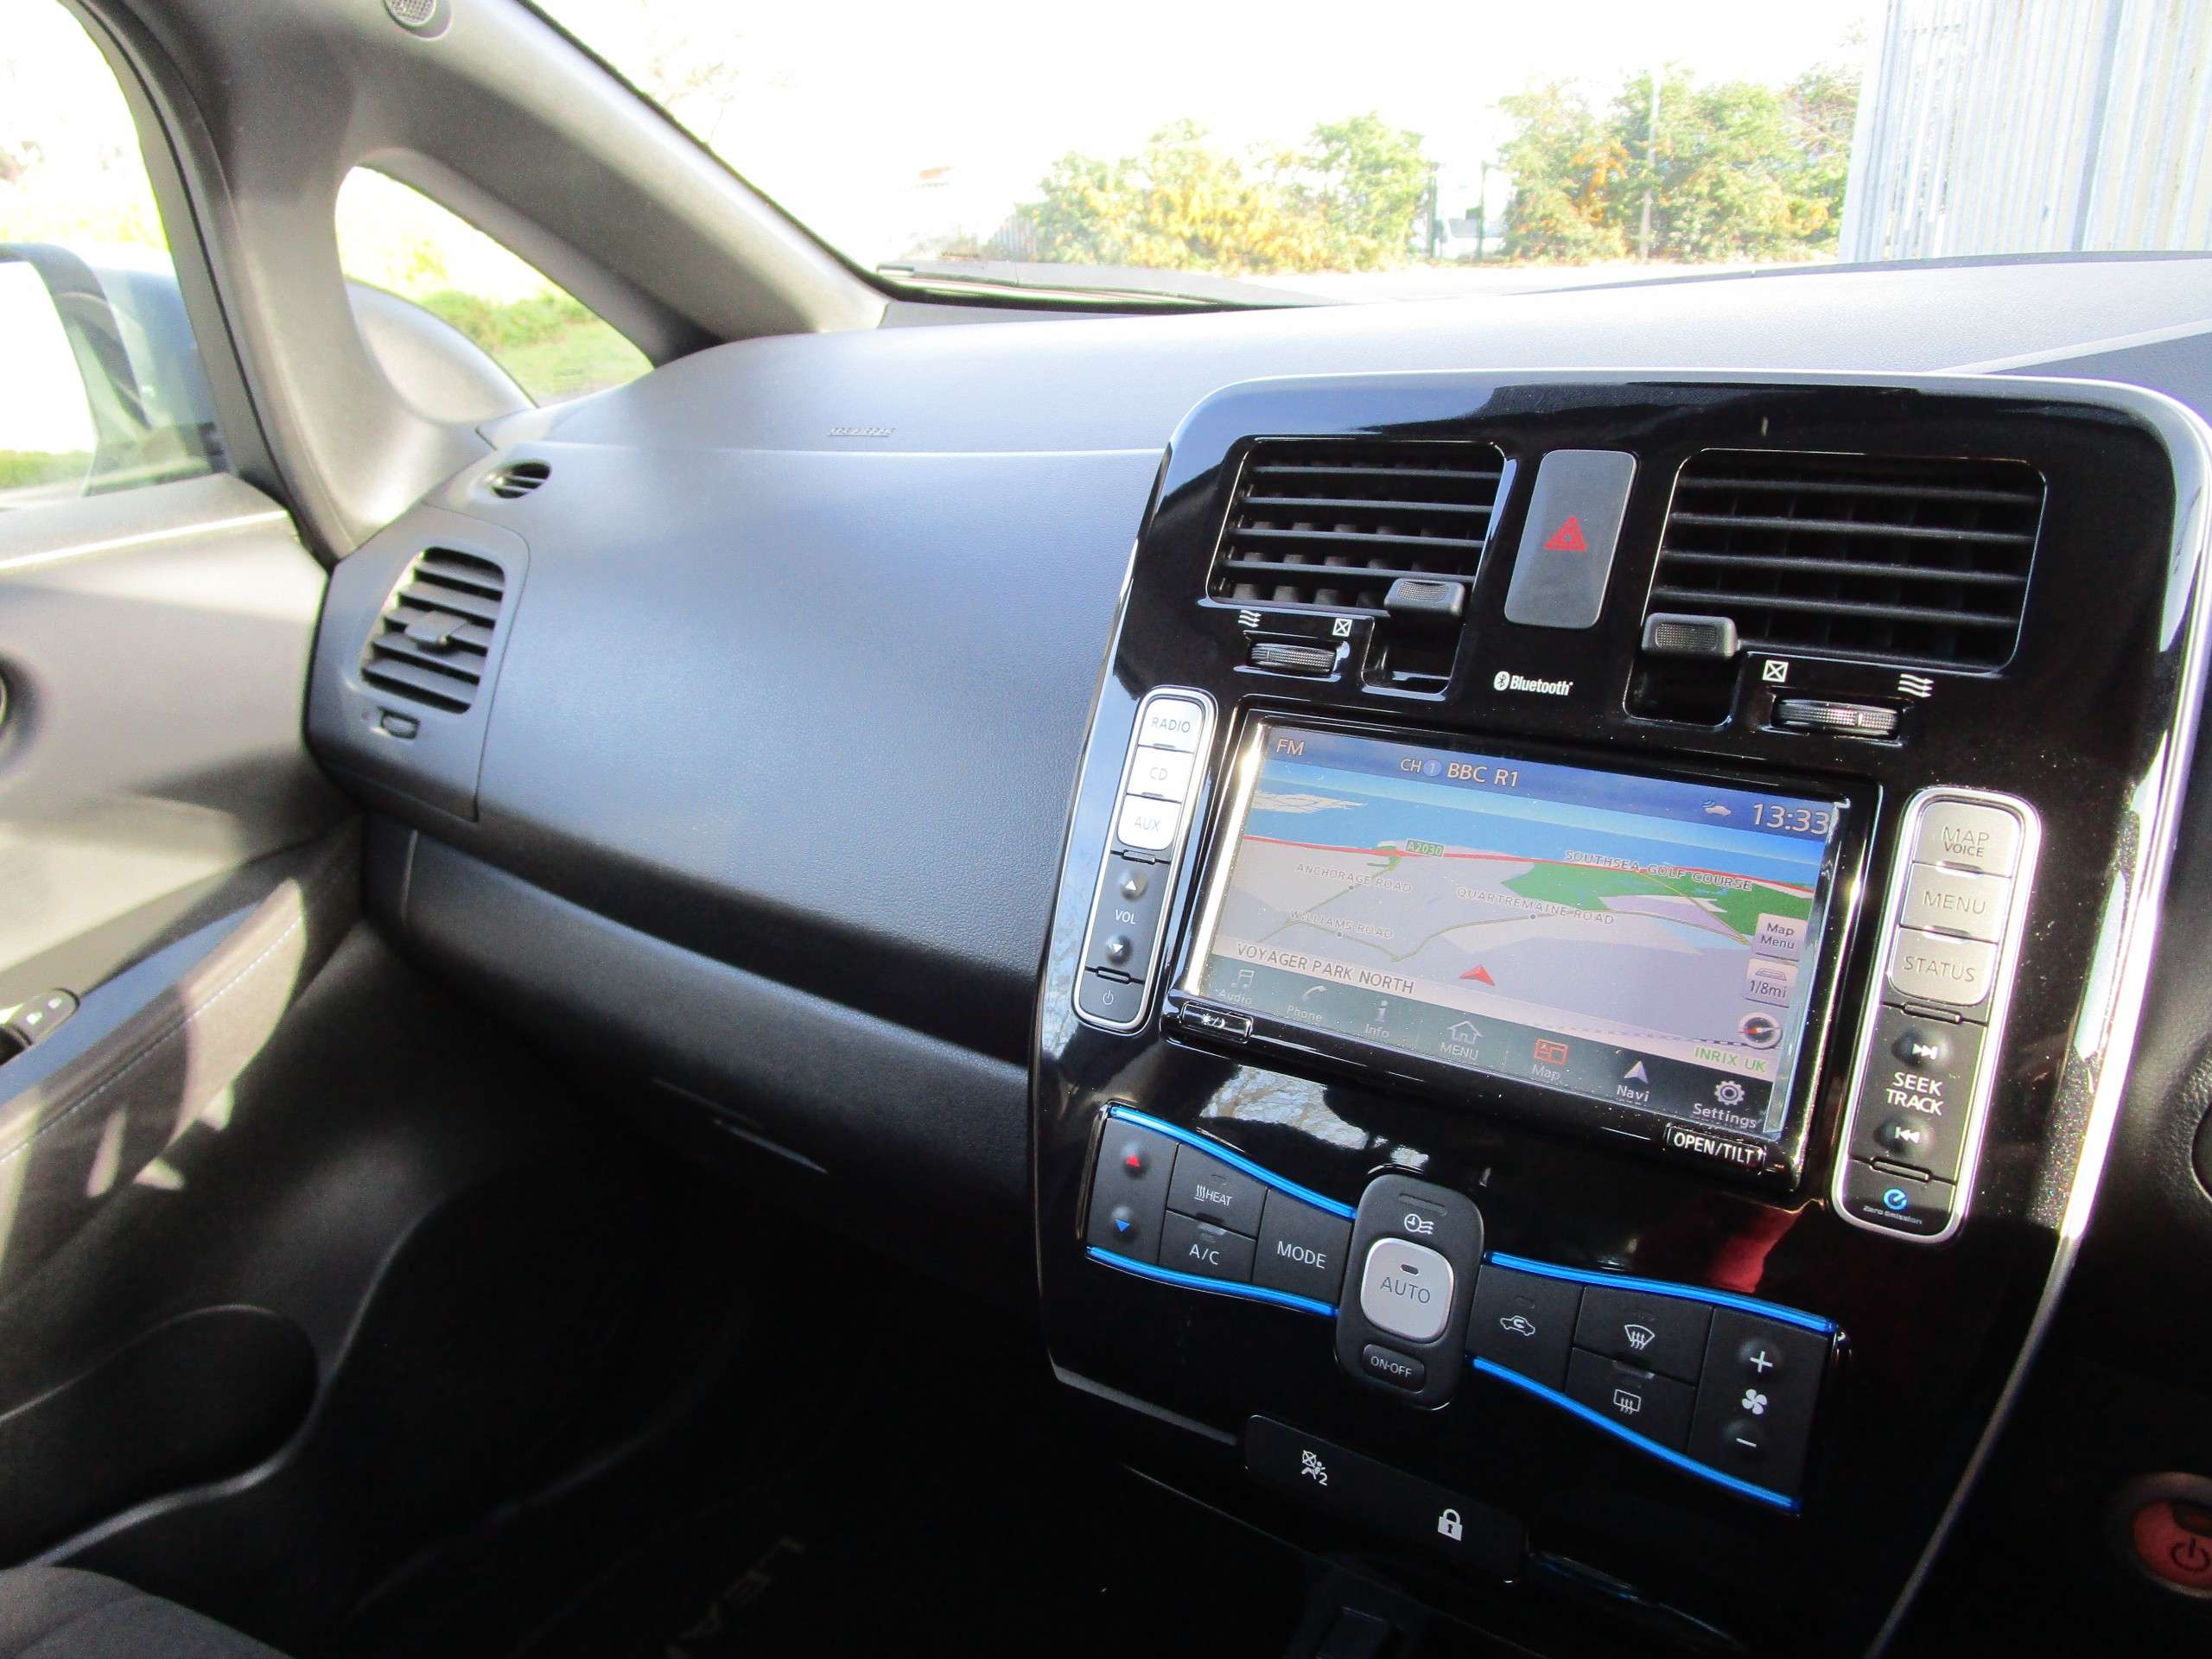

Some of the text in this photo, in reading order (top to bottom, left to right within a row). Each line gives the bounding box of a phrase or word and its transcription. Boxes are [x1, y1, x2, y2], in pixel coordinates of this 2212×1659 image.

[1510, 675, 1570, 696] Bluetooth
[1150, 716, 1192, 734] RADIO
[1276, 738, 1306, 756] FM
[1149, 767, 1168, 782] CD
[1400, 758, 1422, 773] CH
[1447, 761, 1487, 783] BBC
[1494, 769, 1520, 788] R1
[1134, 817, 1161, 832] AUX
[1753, 803, 1829, 835] 13:33
[1942, 826, 1990, 846] MAP
[1407, 842, 1442, 855] A2030
[1943, 842, 1985, 858] VOICE
[1296, 863, 1413, 893] ANCHORAGE ROAD
[1564, 849, 1753, 892] SOUTHSEA GOLF COURSE
[1458, 888, 1615, 925] QUARTREMAINE ROAD
[1923, 891, 1986, 915] MENU
[1116, 909, 1136, 925] VOL
[1356, 924, 1394, 939] ROAD
[1766, 922, 1795, 937] Map
[1760, 935, 1795, 950] Menu
[1236, 943, 1414, 995] VOYAGER PARK NORTH
[1904, 956, 1975, 982] STATUS
[1217, 989, 1252, 1005] Audio
[1750, 980, 1787, 998] 1/8mi
[1287, 1004, 1323, 1023] Phone
[1364, 1022, 1390, 1039] Info
[1440, 1040, 1480, 1061] MENU
[1694, 1046, 1768, 1073] INRIX UK
[1532, 1064, 1561, 1083] Map
[1892, 1071, 1943, 1096] SEEK
[1617, 1084, 1650, 1103] Navi
[1885, 1088, 1944, 1116] TRACK
[1693, 1103, 1757, 1130] Settings
[1674, 1130, 1755, 1164] OPEN/TILT
[1205, 1191, 1233, 1207] HEAT
[1189, 1243, 1220, 1266] A/C
[1276, 1241, 1327, 1270] MODE
[1380, 1276, 1431, 1304] AUTO
